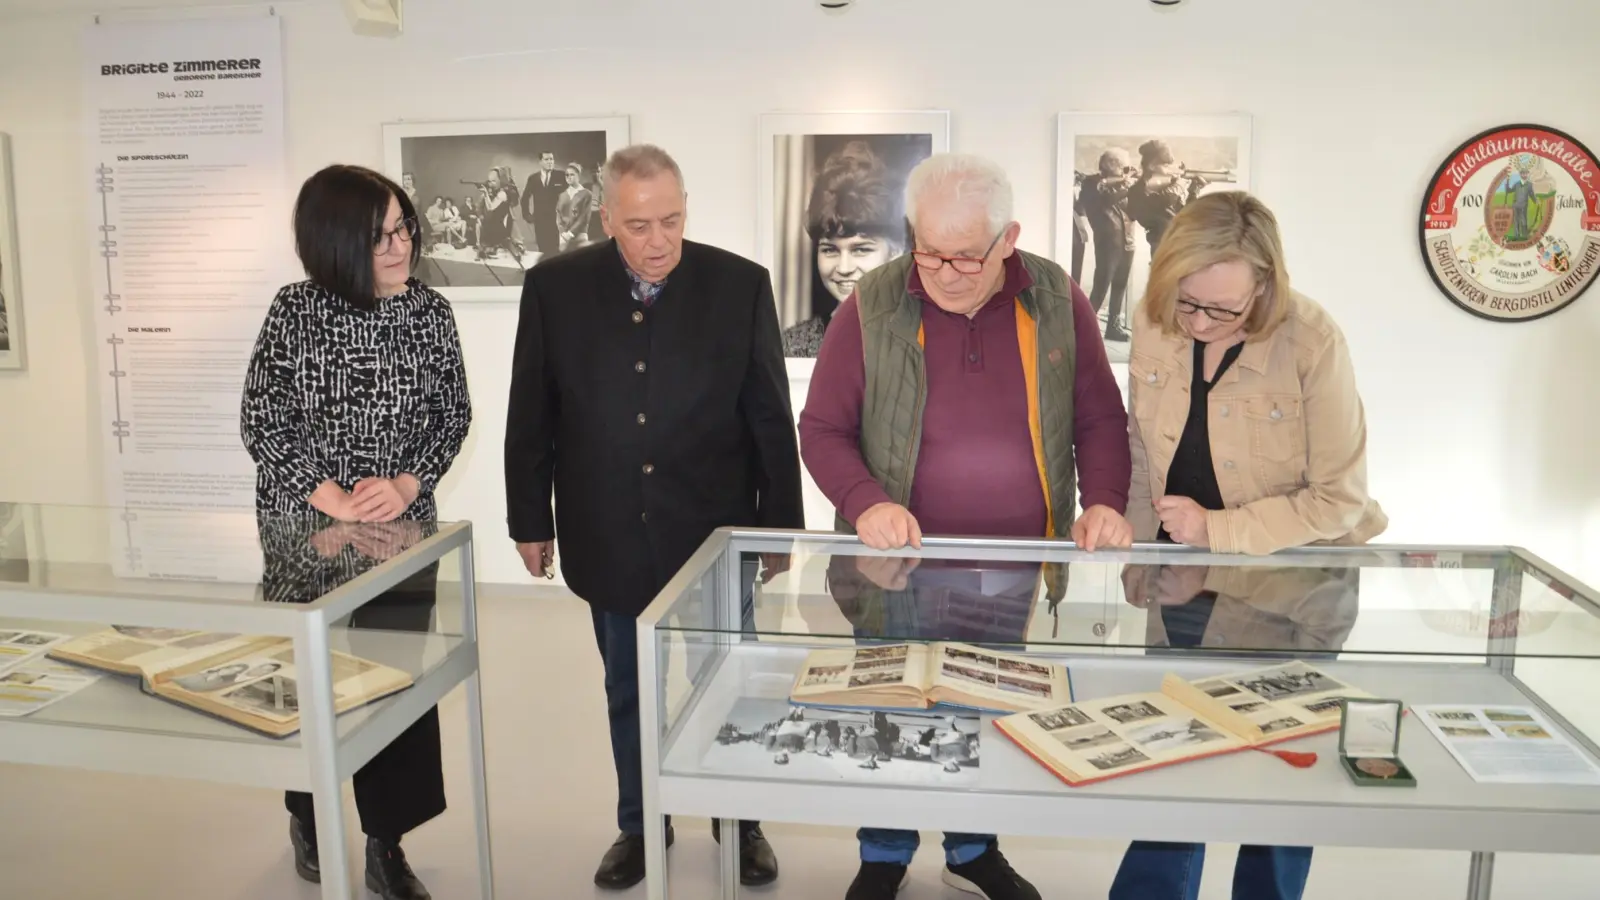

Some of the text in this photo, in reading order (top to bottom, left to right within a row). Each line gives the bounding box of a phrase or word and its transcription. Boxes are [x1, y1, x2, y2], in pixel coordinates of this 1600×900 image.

[157, 91, 176, 99] 1944
[184, 90, 204, 98] 2022
[1446, 136, 1593, 188] Jubiläumsscheibe
[1462, 193, 1584, 211] 100 Jahre
[1433, 240, 1600, 312] SCHÜTZENVEREIN BERGDISTEL LENTERSHEIM
[1489, 267, 1538, 279] CAROLIN BACH
